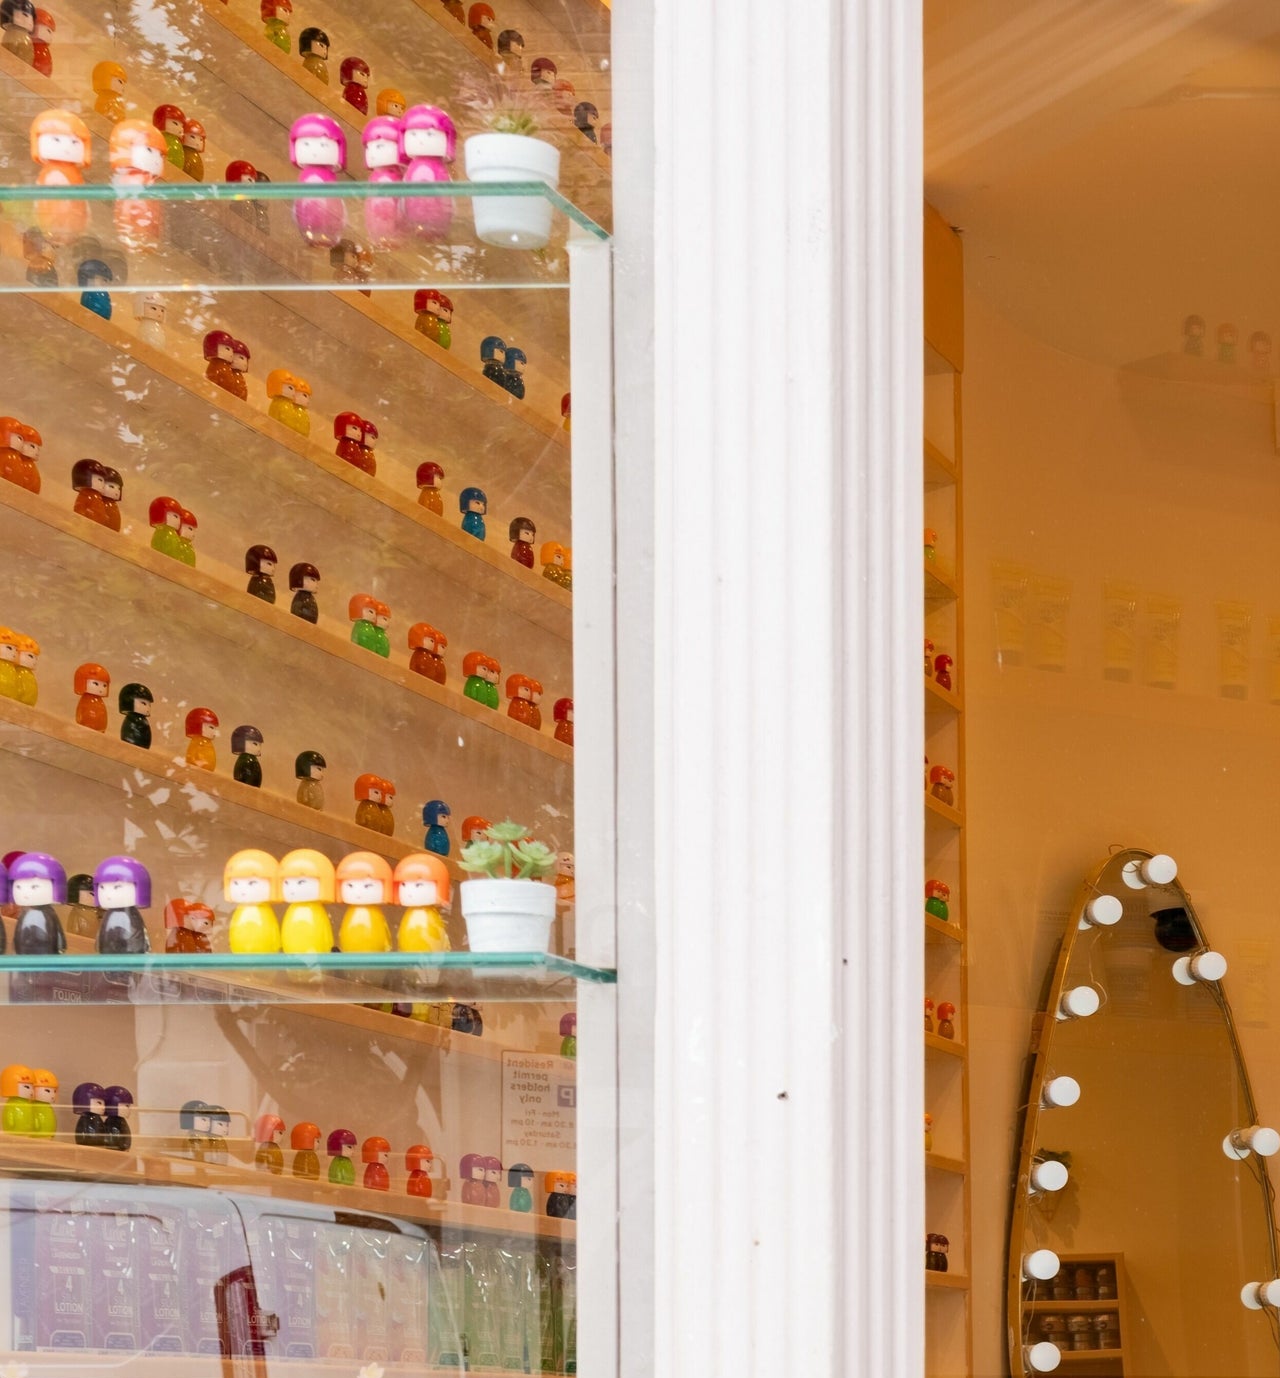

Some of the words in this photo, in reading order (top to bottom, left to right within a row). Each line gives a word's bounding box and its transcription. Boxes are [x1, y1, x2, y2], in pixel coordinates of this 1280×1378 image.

[66, 1275, 73, 1292] 4
[55, 1303, 83, 1313] LOTION
[108, 1305, 133, 1315] LOTION
[154, 1308, 180, 1318] LOTION
